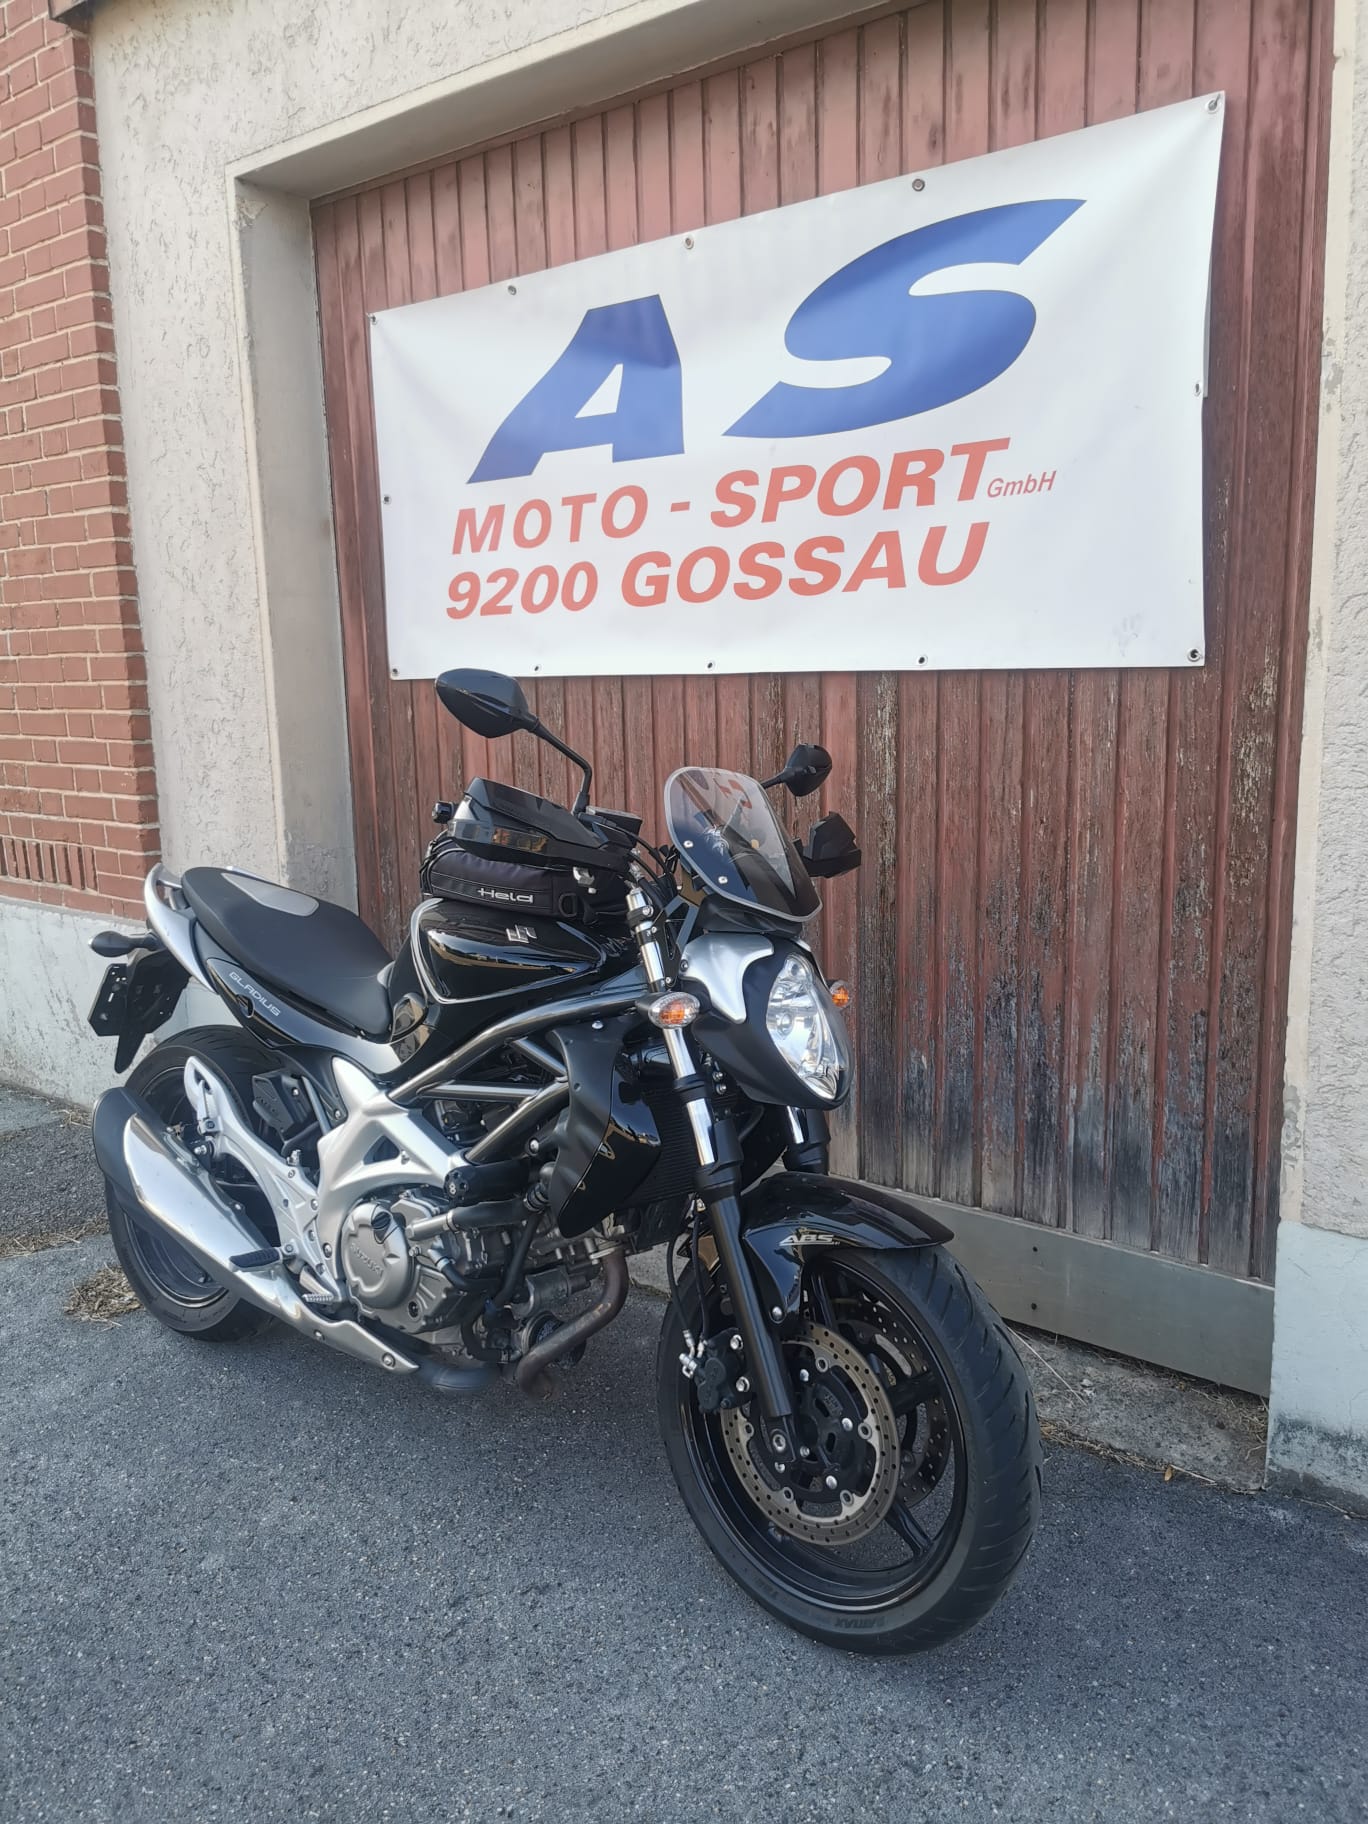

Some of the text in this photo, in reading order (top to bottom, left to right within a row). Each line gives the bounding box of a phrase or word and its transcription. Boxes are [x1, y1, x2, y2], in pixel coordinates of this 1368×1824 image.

[451, 484, 649, 556] MOTO
[709, 437, 1011, 528] SPORT
[987, 470, 1057, 498] GmbH
[445, 521, 990, 621] 9200 GOSSAU
[477, 887, 533, 904] Held
[229, 971, 281, 1017] GLADIUS
[779, 1234, 834, 1246] ABS
